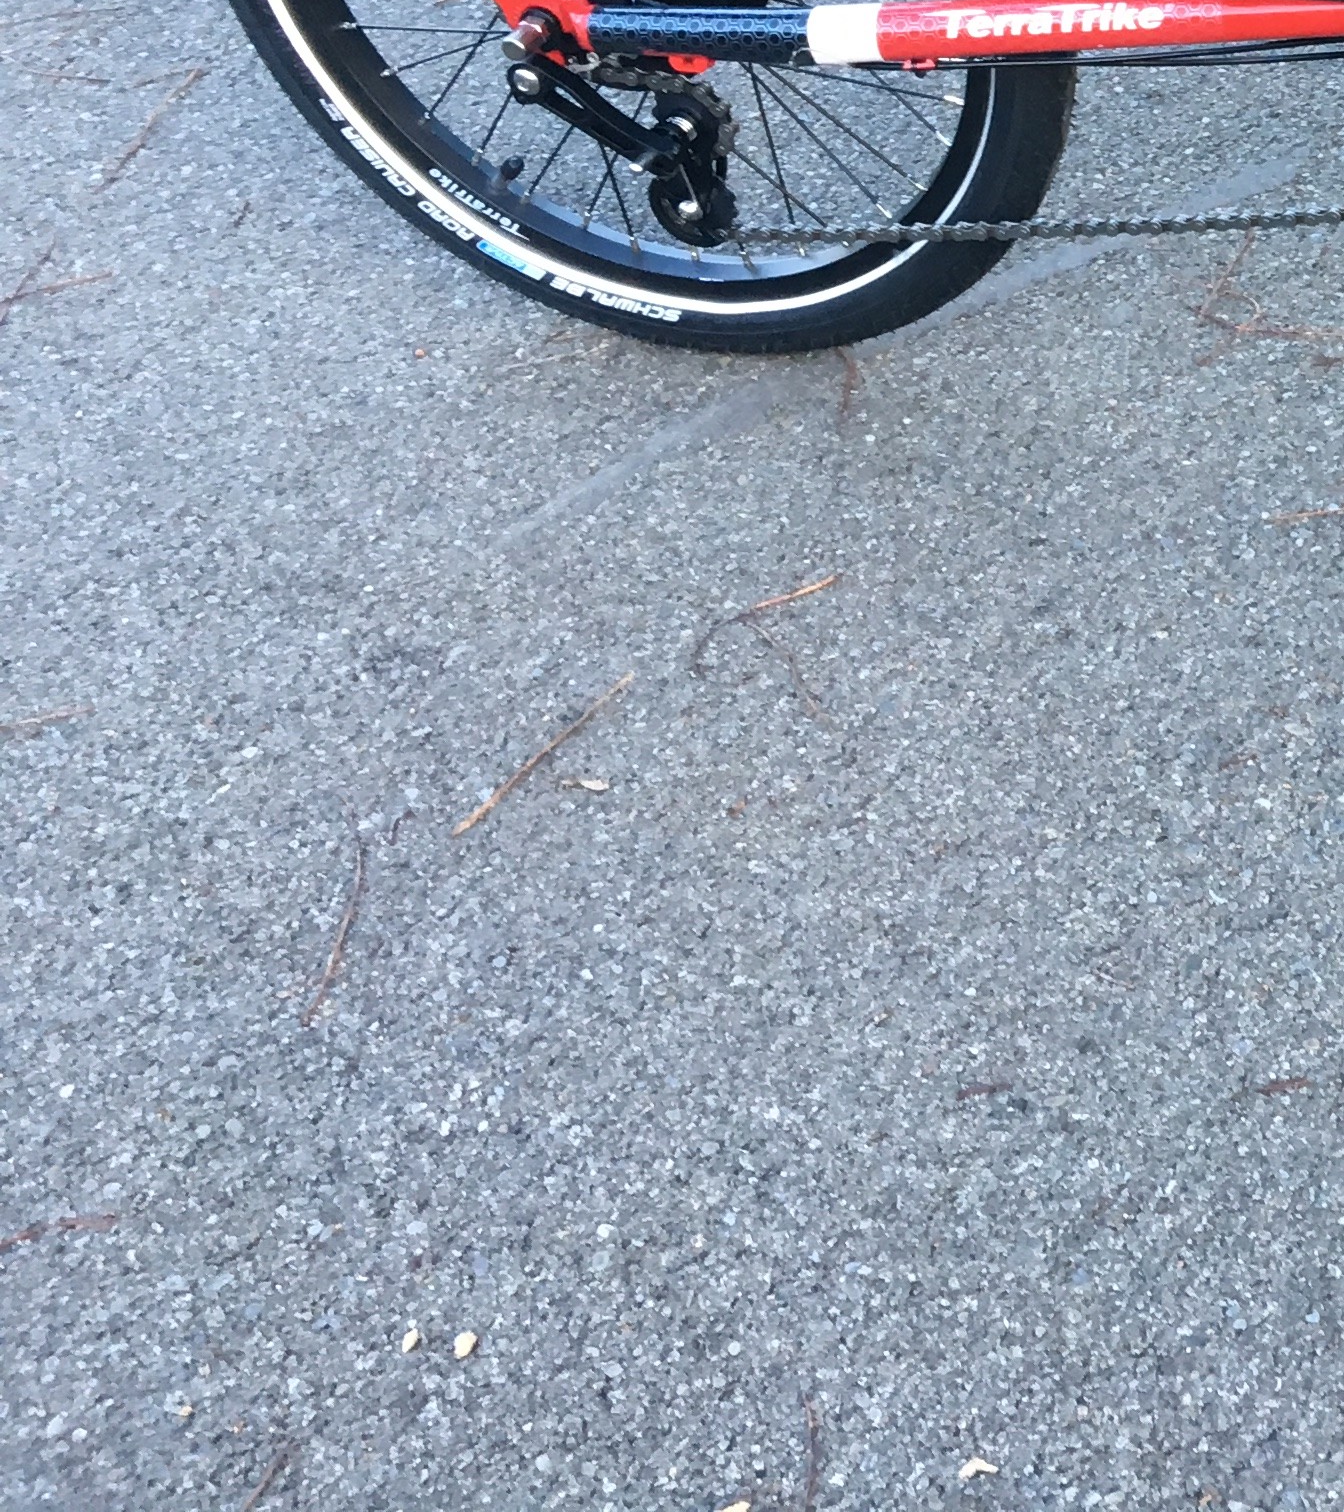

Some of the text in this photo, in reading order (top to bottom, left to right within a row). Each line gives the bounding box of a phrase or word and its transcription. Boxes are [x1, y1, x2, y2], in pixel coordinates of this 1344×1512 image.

[919, 2, 1165, 39] TerraTrike
[340, 126, 416, 196] CRUISER
[417, 200, 476, 241] ROAD
[428, 168, 530, 242] TerraTrike
[550, 276, 682, 322] SCHWALBE
